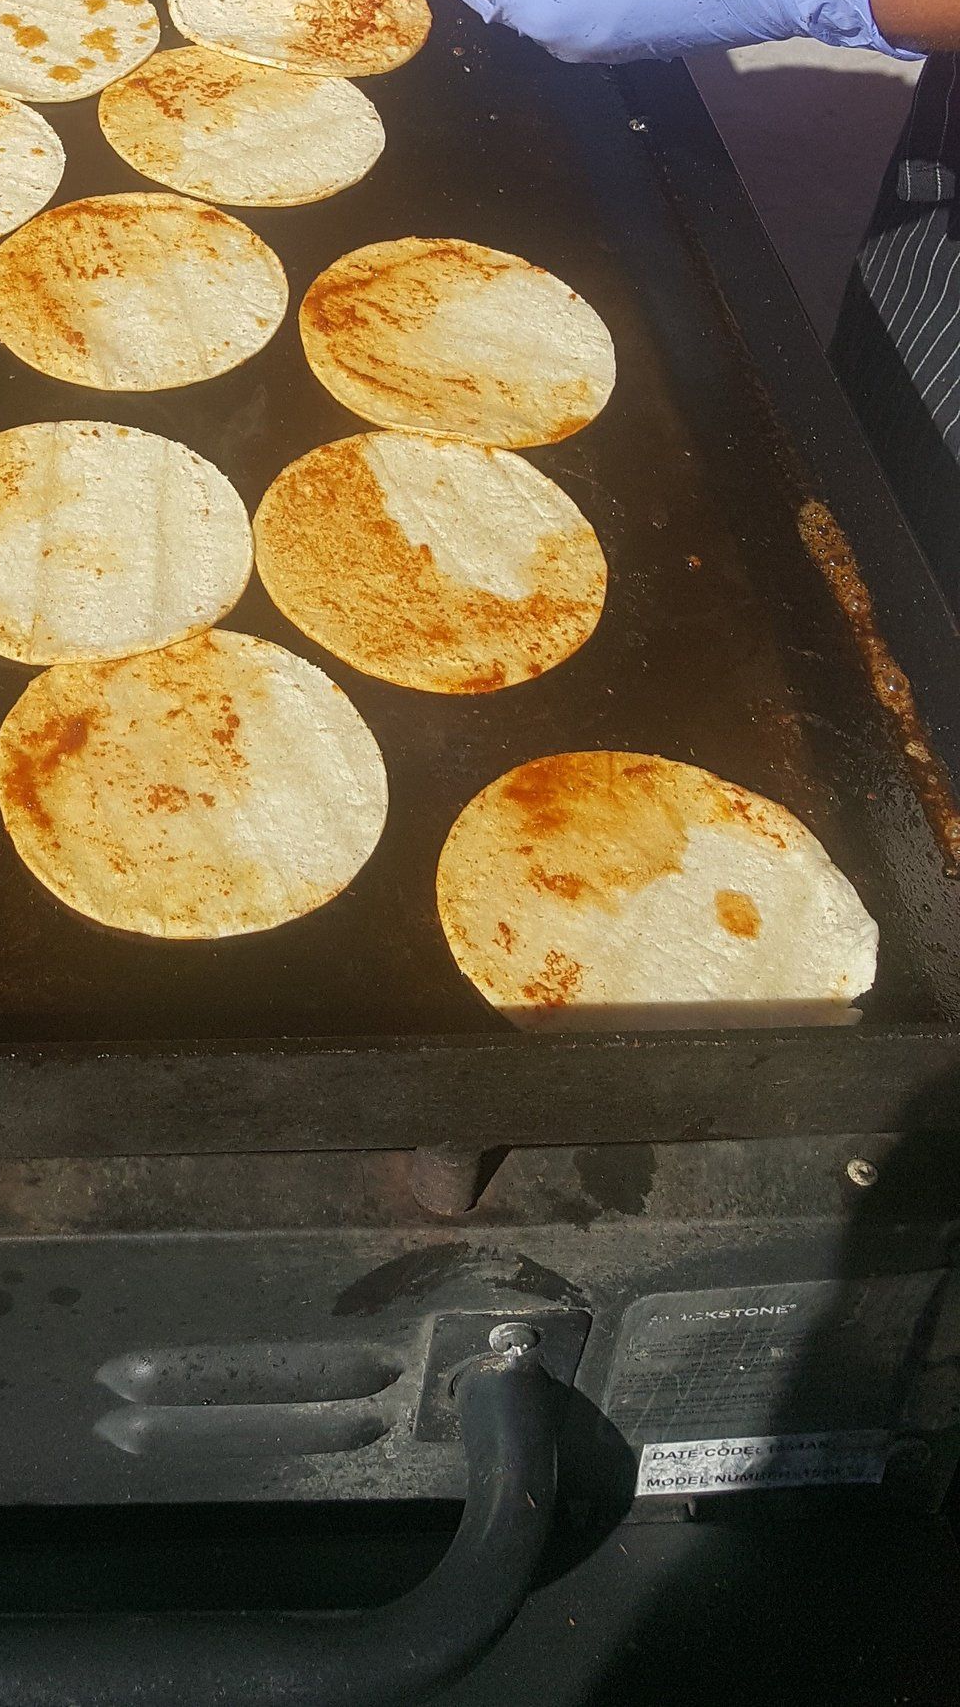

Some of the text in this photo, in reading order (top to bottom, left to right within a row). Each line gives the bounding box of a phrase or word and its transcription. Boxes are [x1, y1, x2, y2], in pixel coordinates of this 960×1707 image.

[652, 1449, 699, 1461] DATE
[704, 1445, 761, 1458] CODE:
[646, 1476, 709, 1488] MODEL
